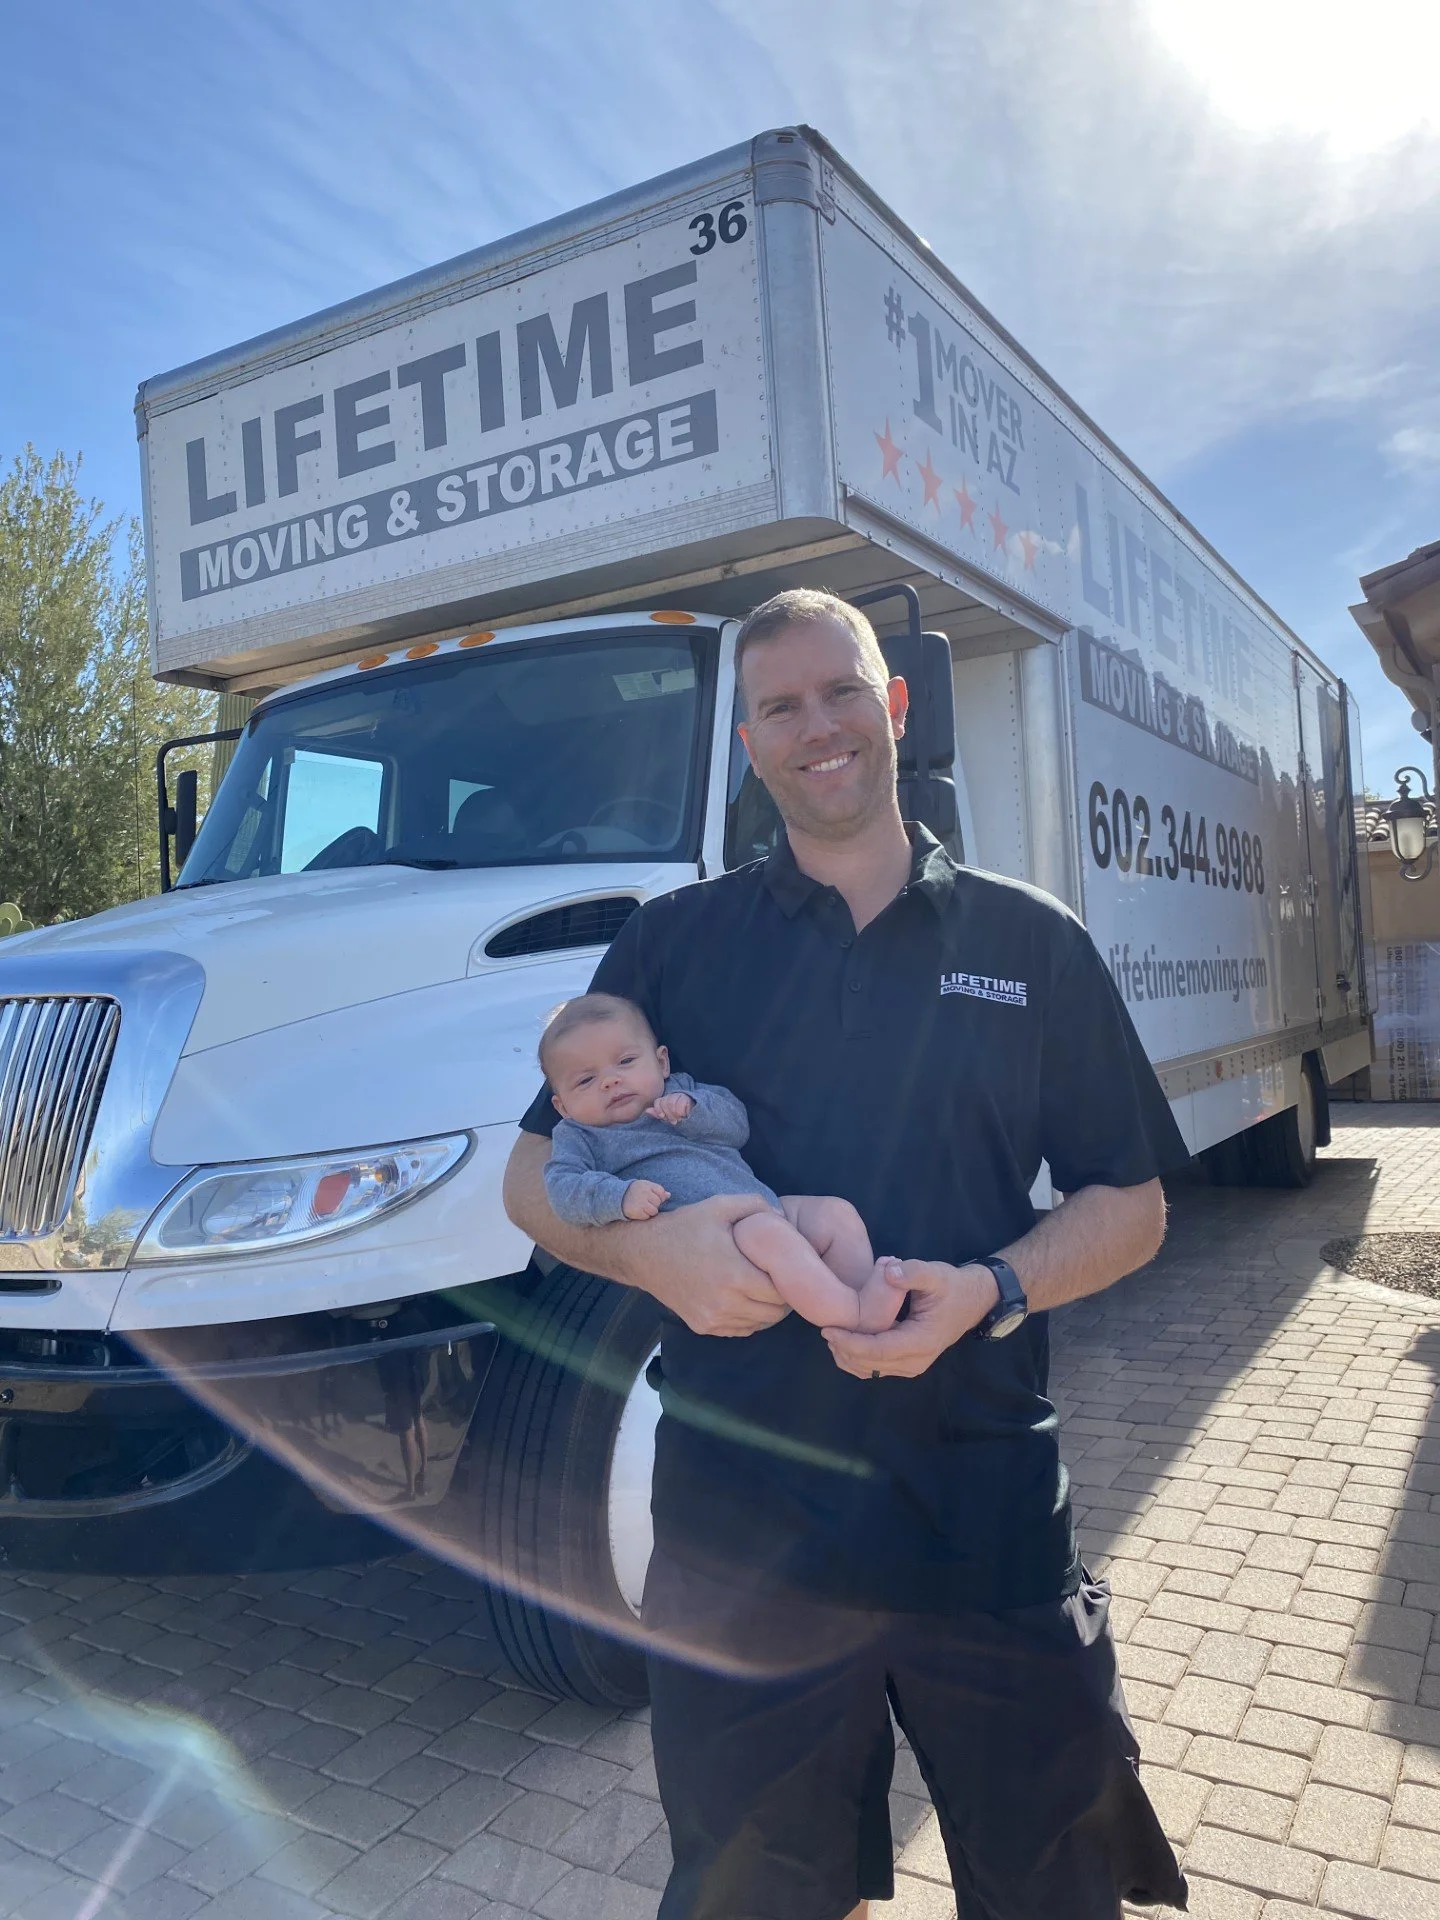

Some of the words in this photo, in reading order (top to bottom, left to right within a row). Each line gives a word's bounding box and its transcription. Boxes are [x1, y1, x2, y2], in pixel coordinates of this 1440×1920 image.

[688, 201, 747, 255] 36
[186, 260, 704, 525] LIFETIME
[934, 326, 1025, 452] MOVER
[198, 509, 368, 590] MOVING
[387, 490, 419, 538] &
[436, 407, 697, 522] STORAGE
[949, 394, 979, 464] IN
[986, 431, 1020, 496] AZ
[1075, 481, 1255, 715] LIFETIME
[1090, 643, 1171, 736] MOVING
[1177, 697, 1189, 745] &
[1089, 781, 1265, 894] 602.344.9988
[941, 972, 1027, 996] LIFETIME
[943, 985, 976, 995] MOVING
[986, 992, 1024, 1005] STORAGE
